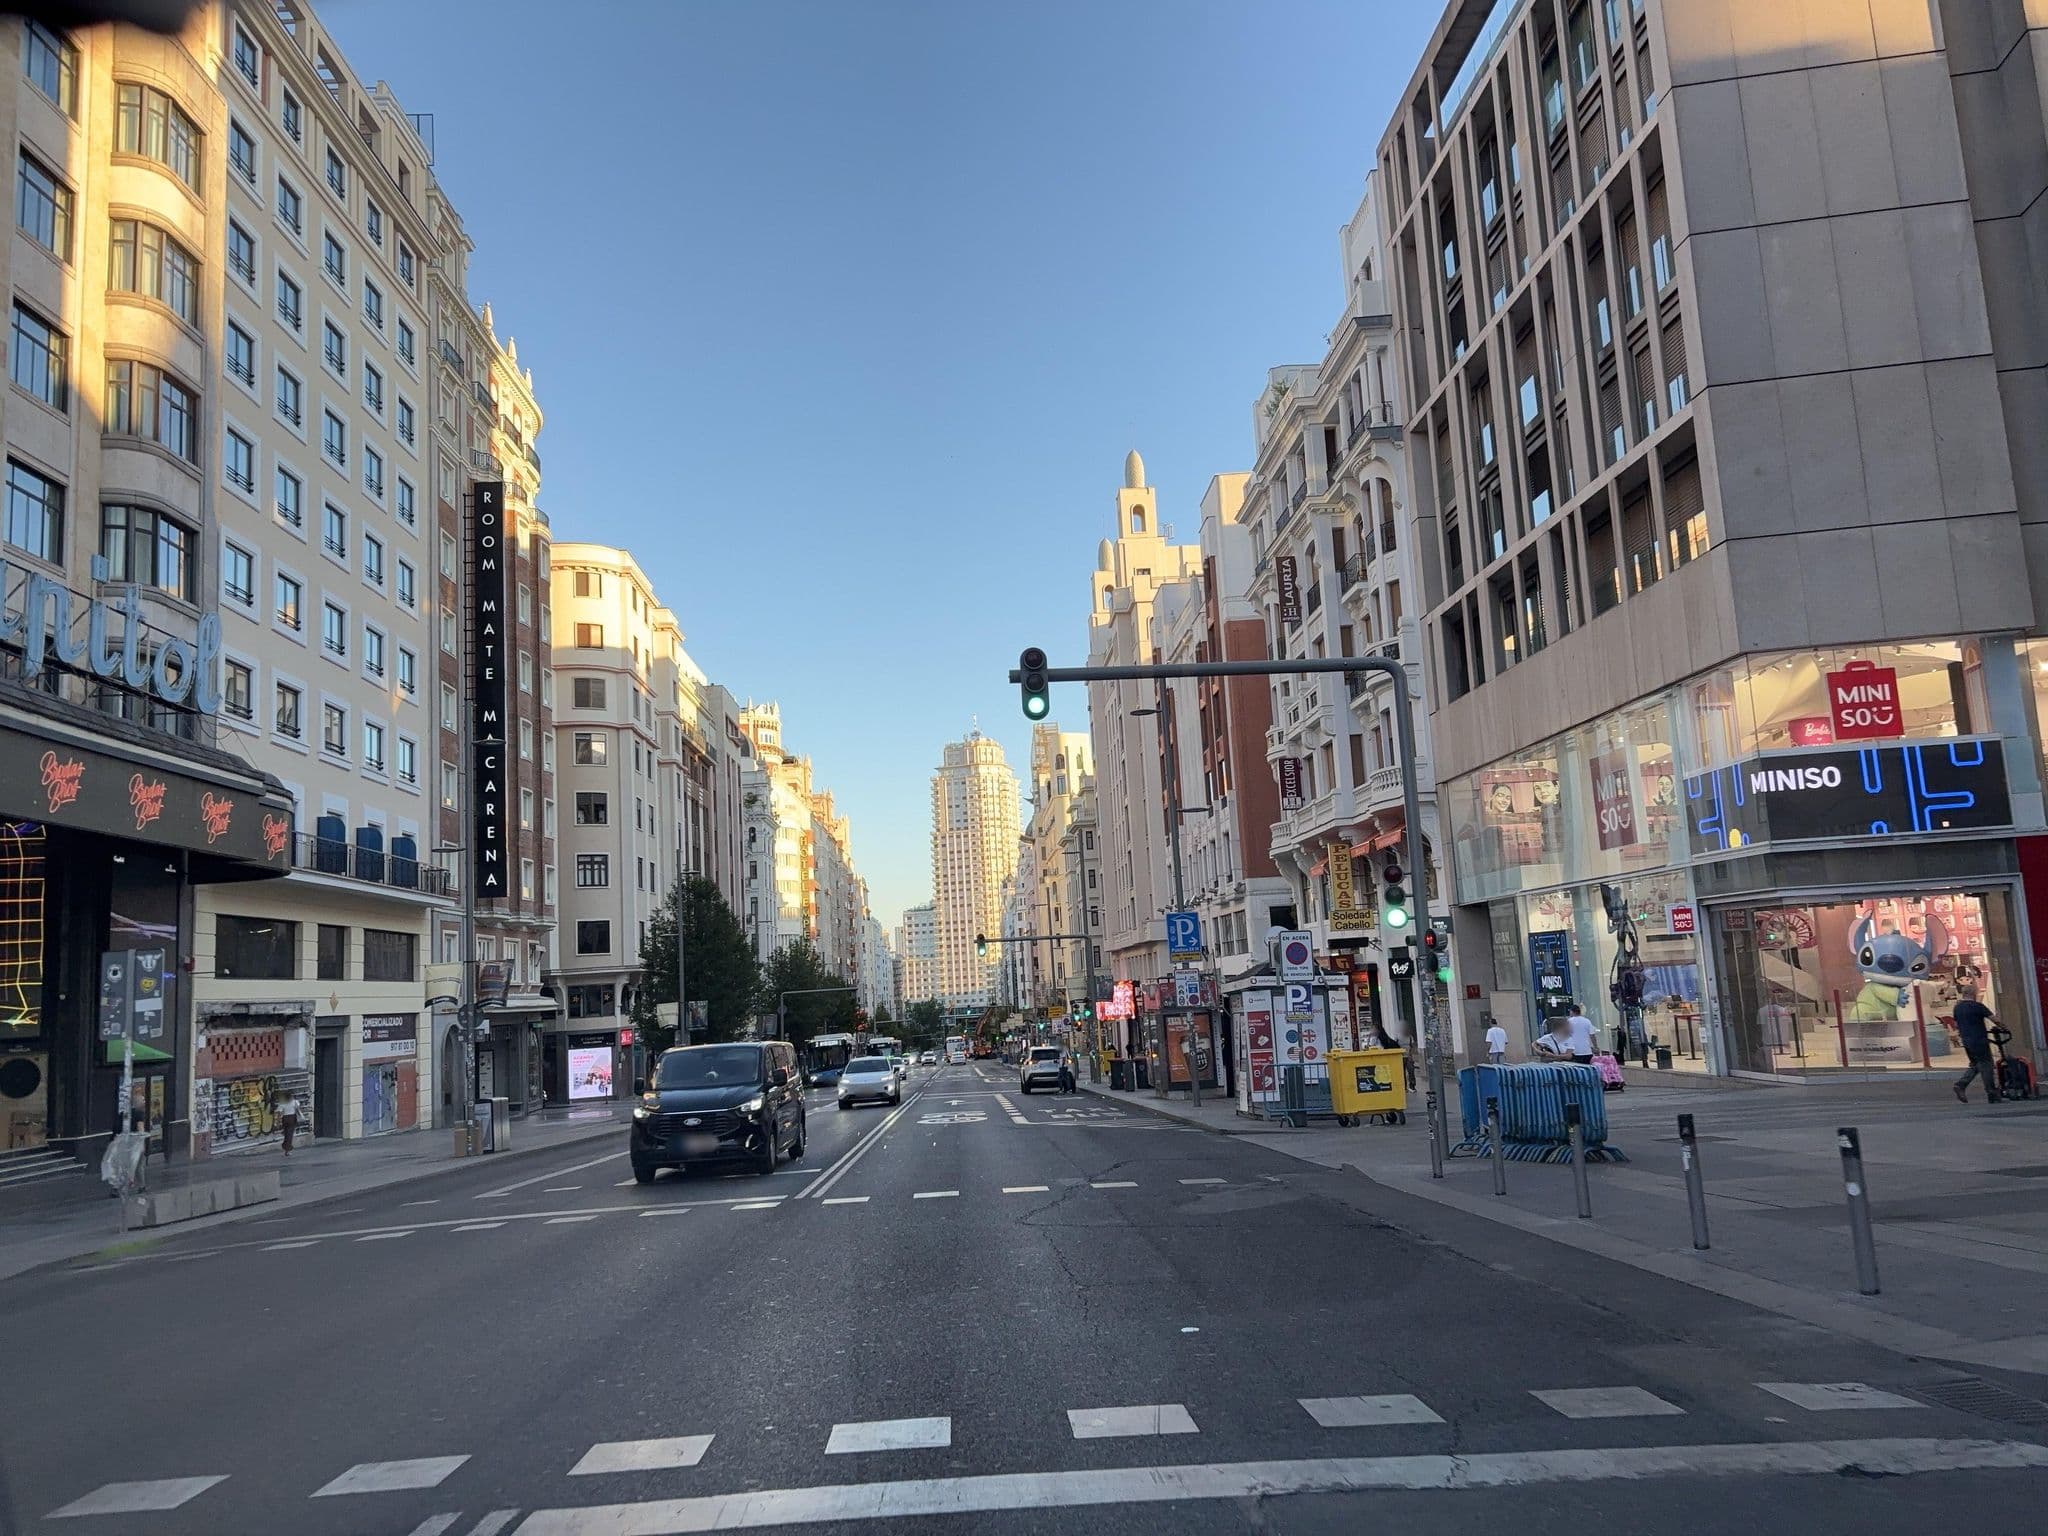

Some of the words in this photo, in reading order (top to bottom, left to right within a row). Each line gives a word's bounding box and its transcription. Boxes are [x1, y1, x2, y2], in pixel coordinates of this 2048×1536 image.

[482, 491, 495, 570] ROOM
[1282, 558, 1294, 606] LAURIA
[482, 599, 496, 680] MATE
[1836, 683, 1891, 705] MINI
[1283, 759, 1297, 798] EXCELSIOR
[1750, 765, 1841, 794] MINISO
[1332, 845, 1352, 908] PELUCAS
[1332, 910, 1371, 920] Soledad
[1335, 920, 1370, 930] Cabello
[1673, 912, 1692, 921] MINI
[1172, 918, 1194, 948] P
[1541, 974, 1563, 989] MINISO
[1286, 984, 1307, 1015] P
